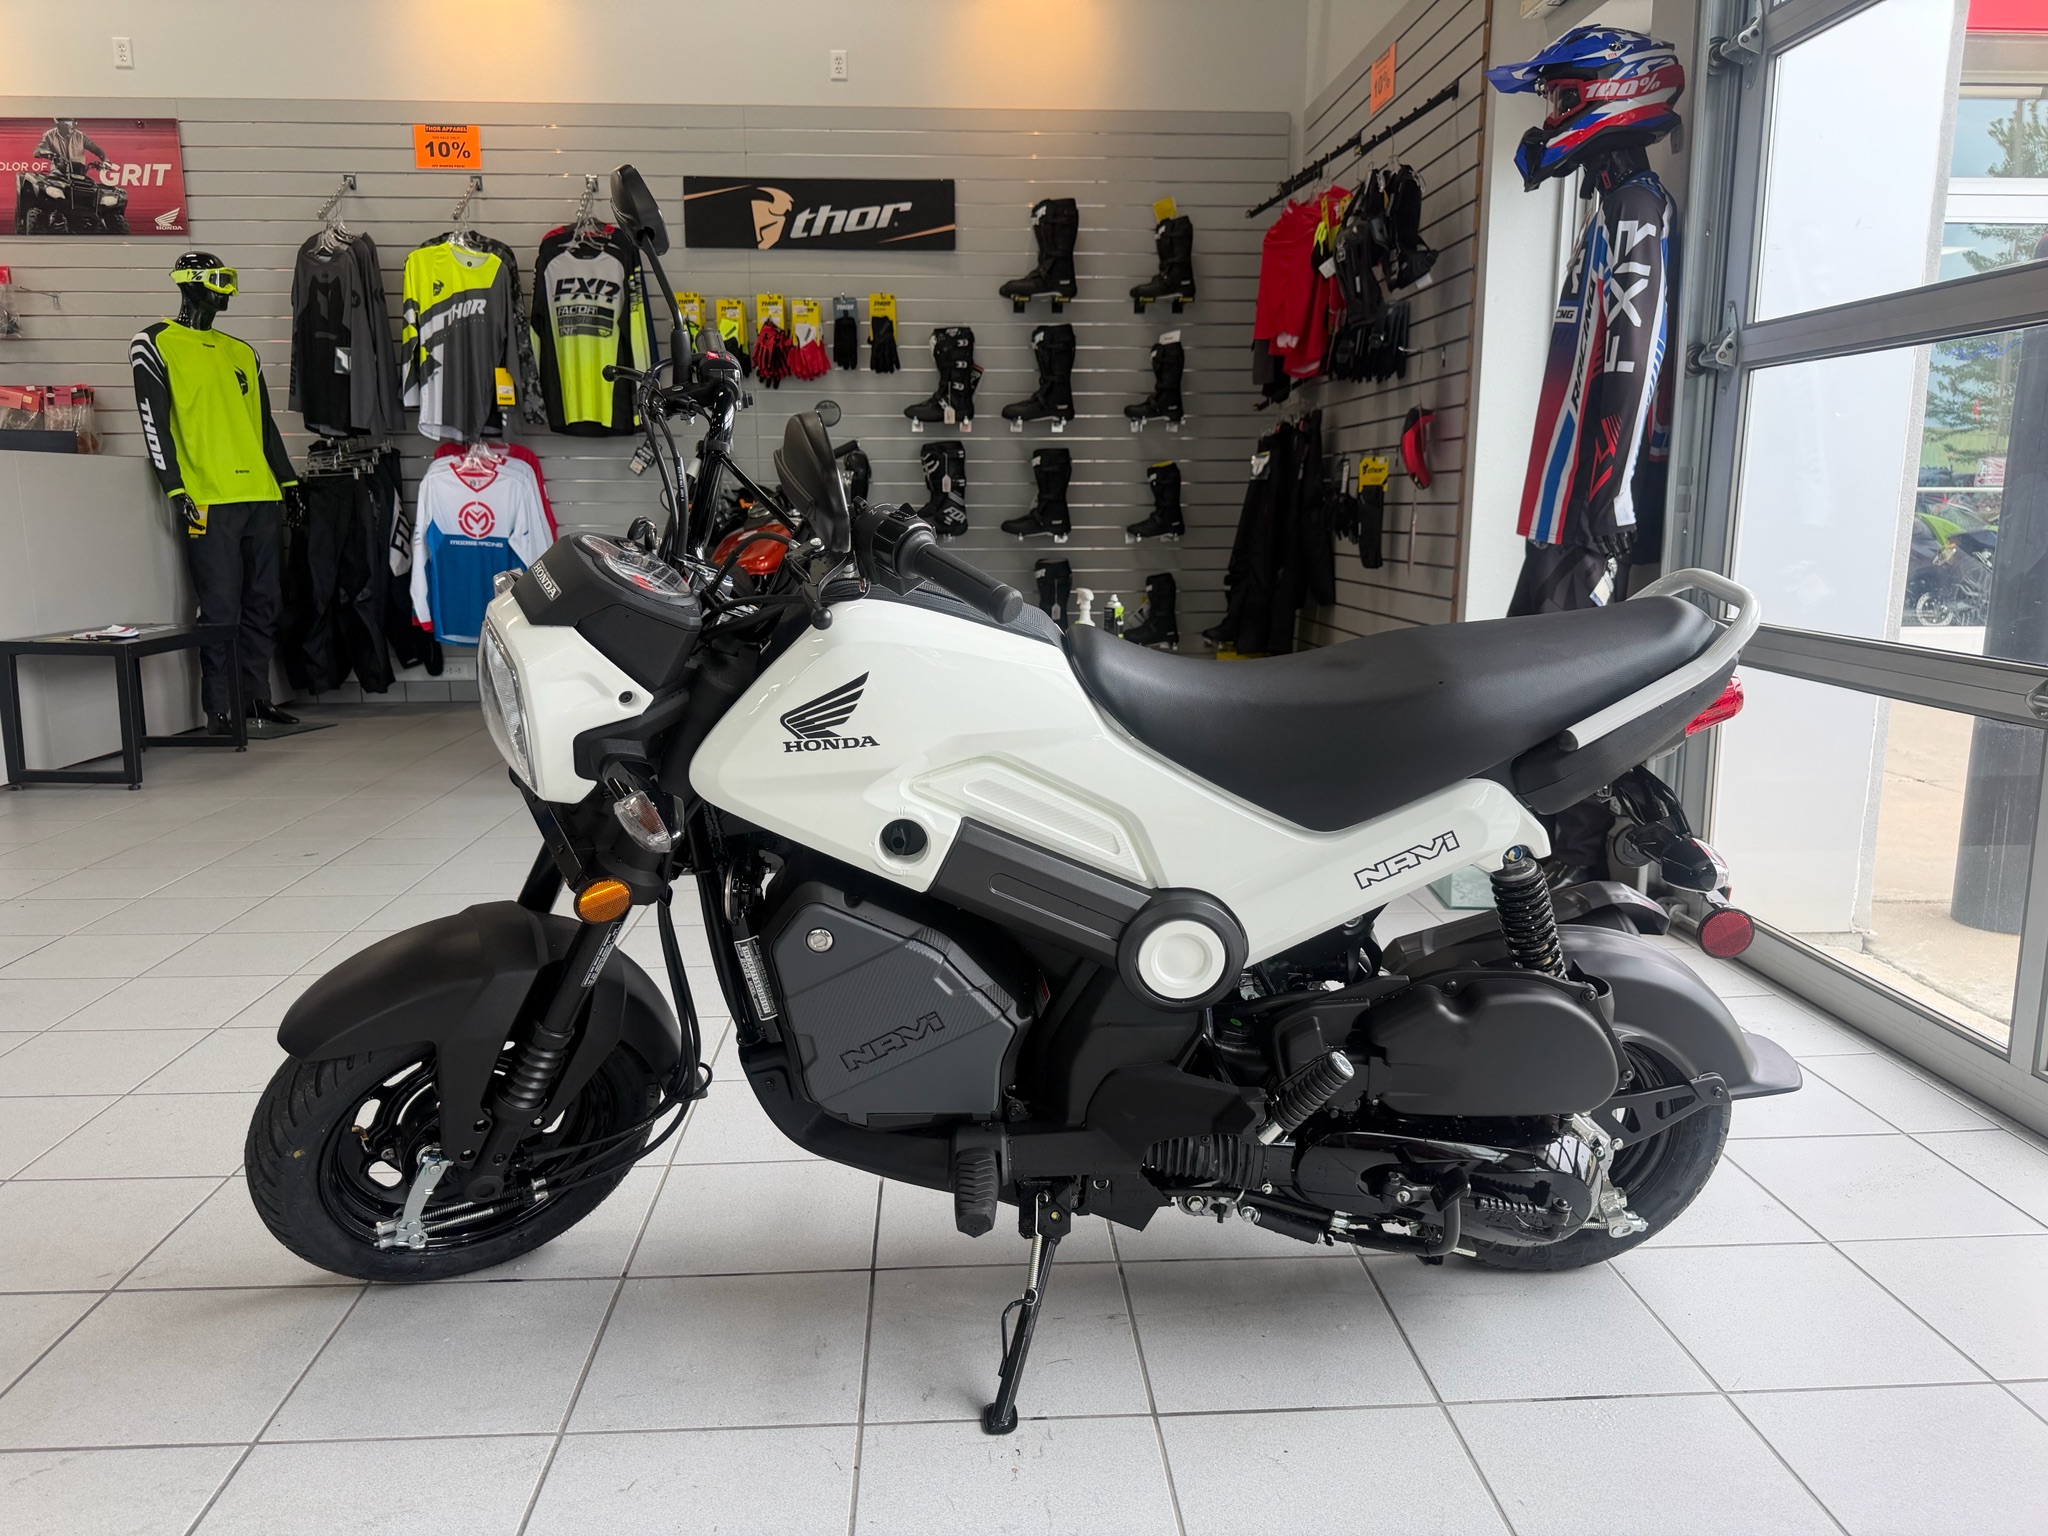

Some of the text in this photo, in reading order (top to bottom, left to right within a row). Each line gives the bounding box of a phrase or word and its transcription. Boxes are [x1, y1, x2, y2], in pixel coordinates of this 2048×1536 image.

[1585, 73, 1661, 98] 100%
[425, 141, 471, 159] 10%
[0, 162, 48, 172] OLOR OF
[99, 163, 172, 187] GRIT
[790, 202, 913, 239] thor
[554, 277, 620, 304] FXR
[1604, 220, 1657, 374] FXR
[440, 299, 487, 327] THOR
[1571, 280, 1597, 414] RACING
[140, 397, 167, 471] THOR
[943, 506, 966, 524] FOX
[533, 562, 557, 599] HONDA
[783, 735, 881, 753] HONDA
